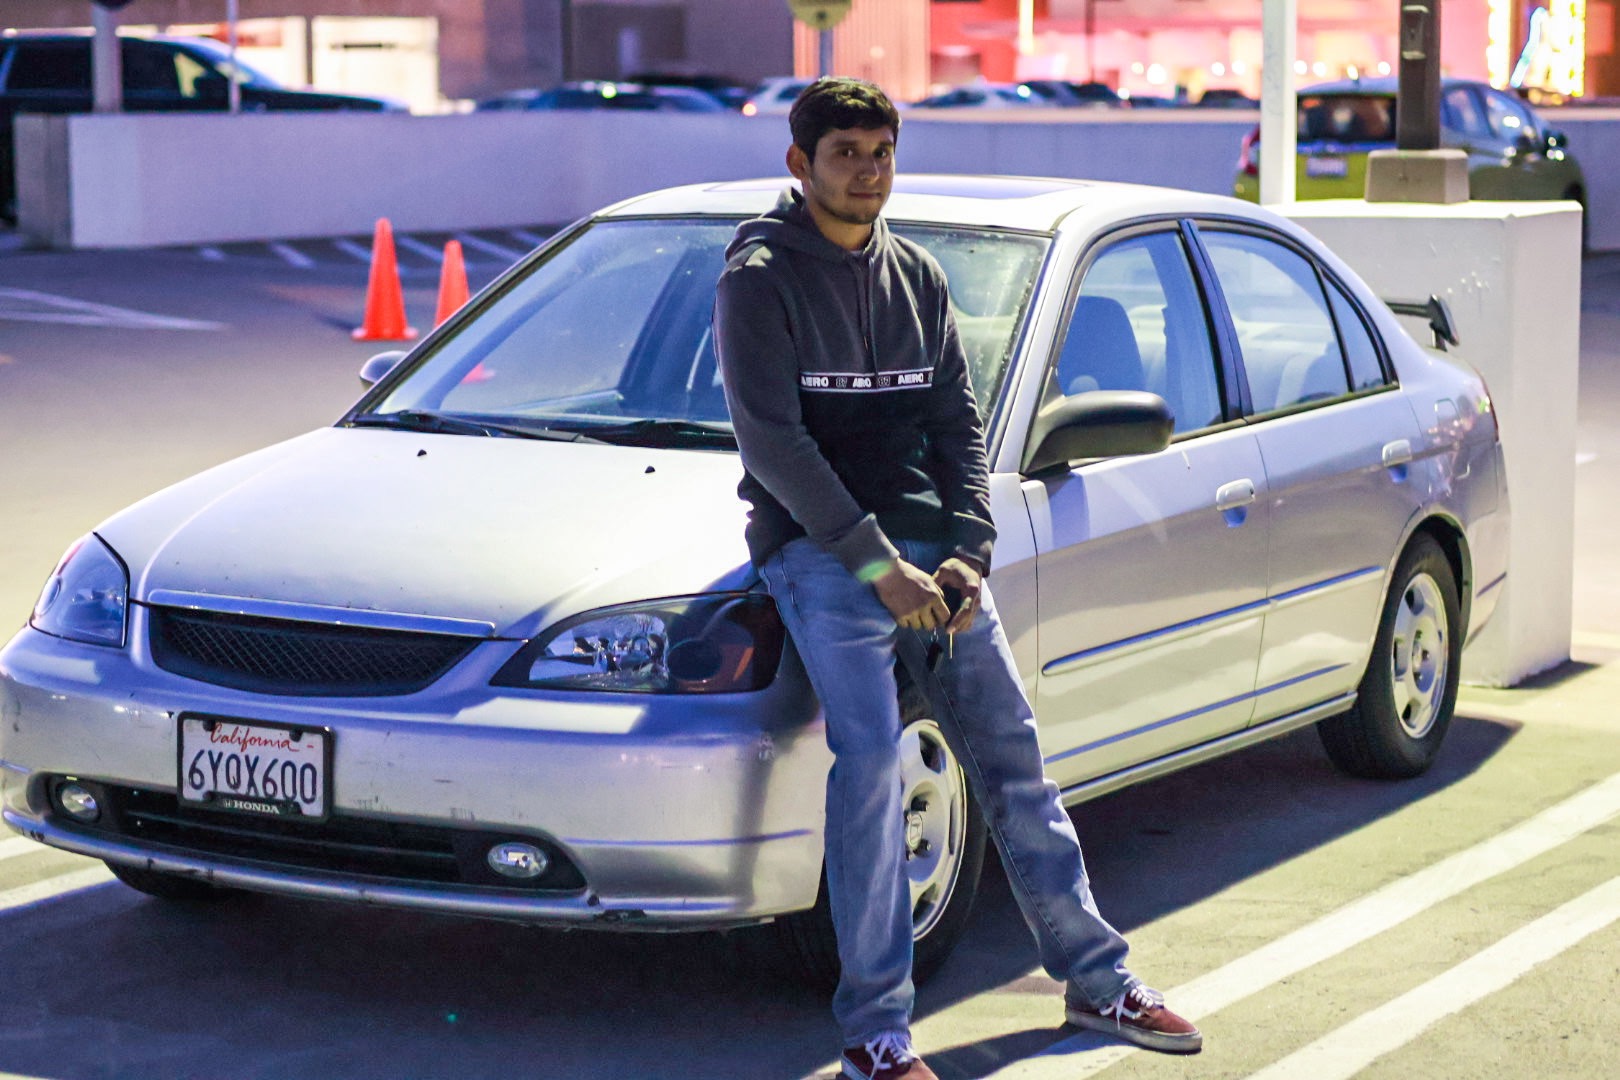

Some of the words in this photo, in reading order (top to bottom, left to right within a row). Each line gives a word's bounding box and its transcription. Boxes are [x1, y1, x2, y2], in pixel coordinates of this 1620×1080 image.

[801, 376, 829, 387] AERO
[897, 373, 924, 385] AERO
[210, 722, 300, 753] California
[188, 750, 318, 804] 6YQX600
[233, 800, 280, 815] HONDA
